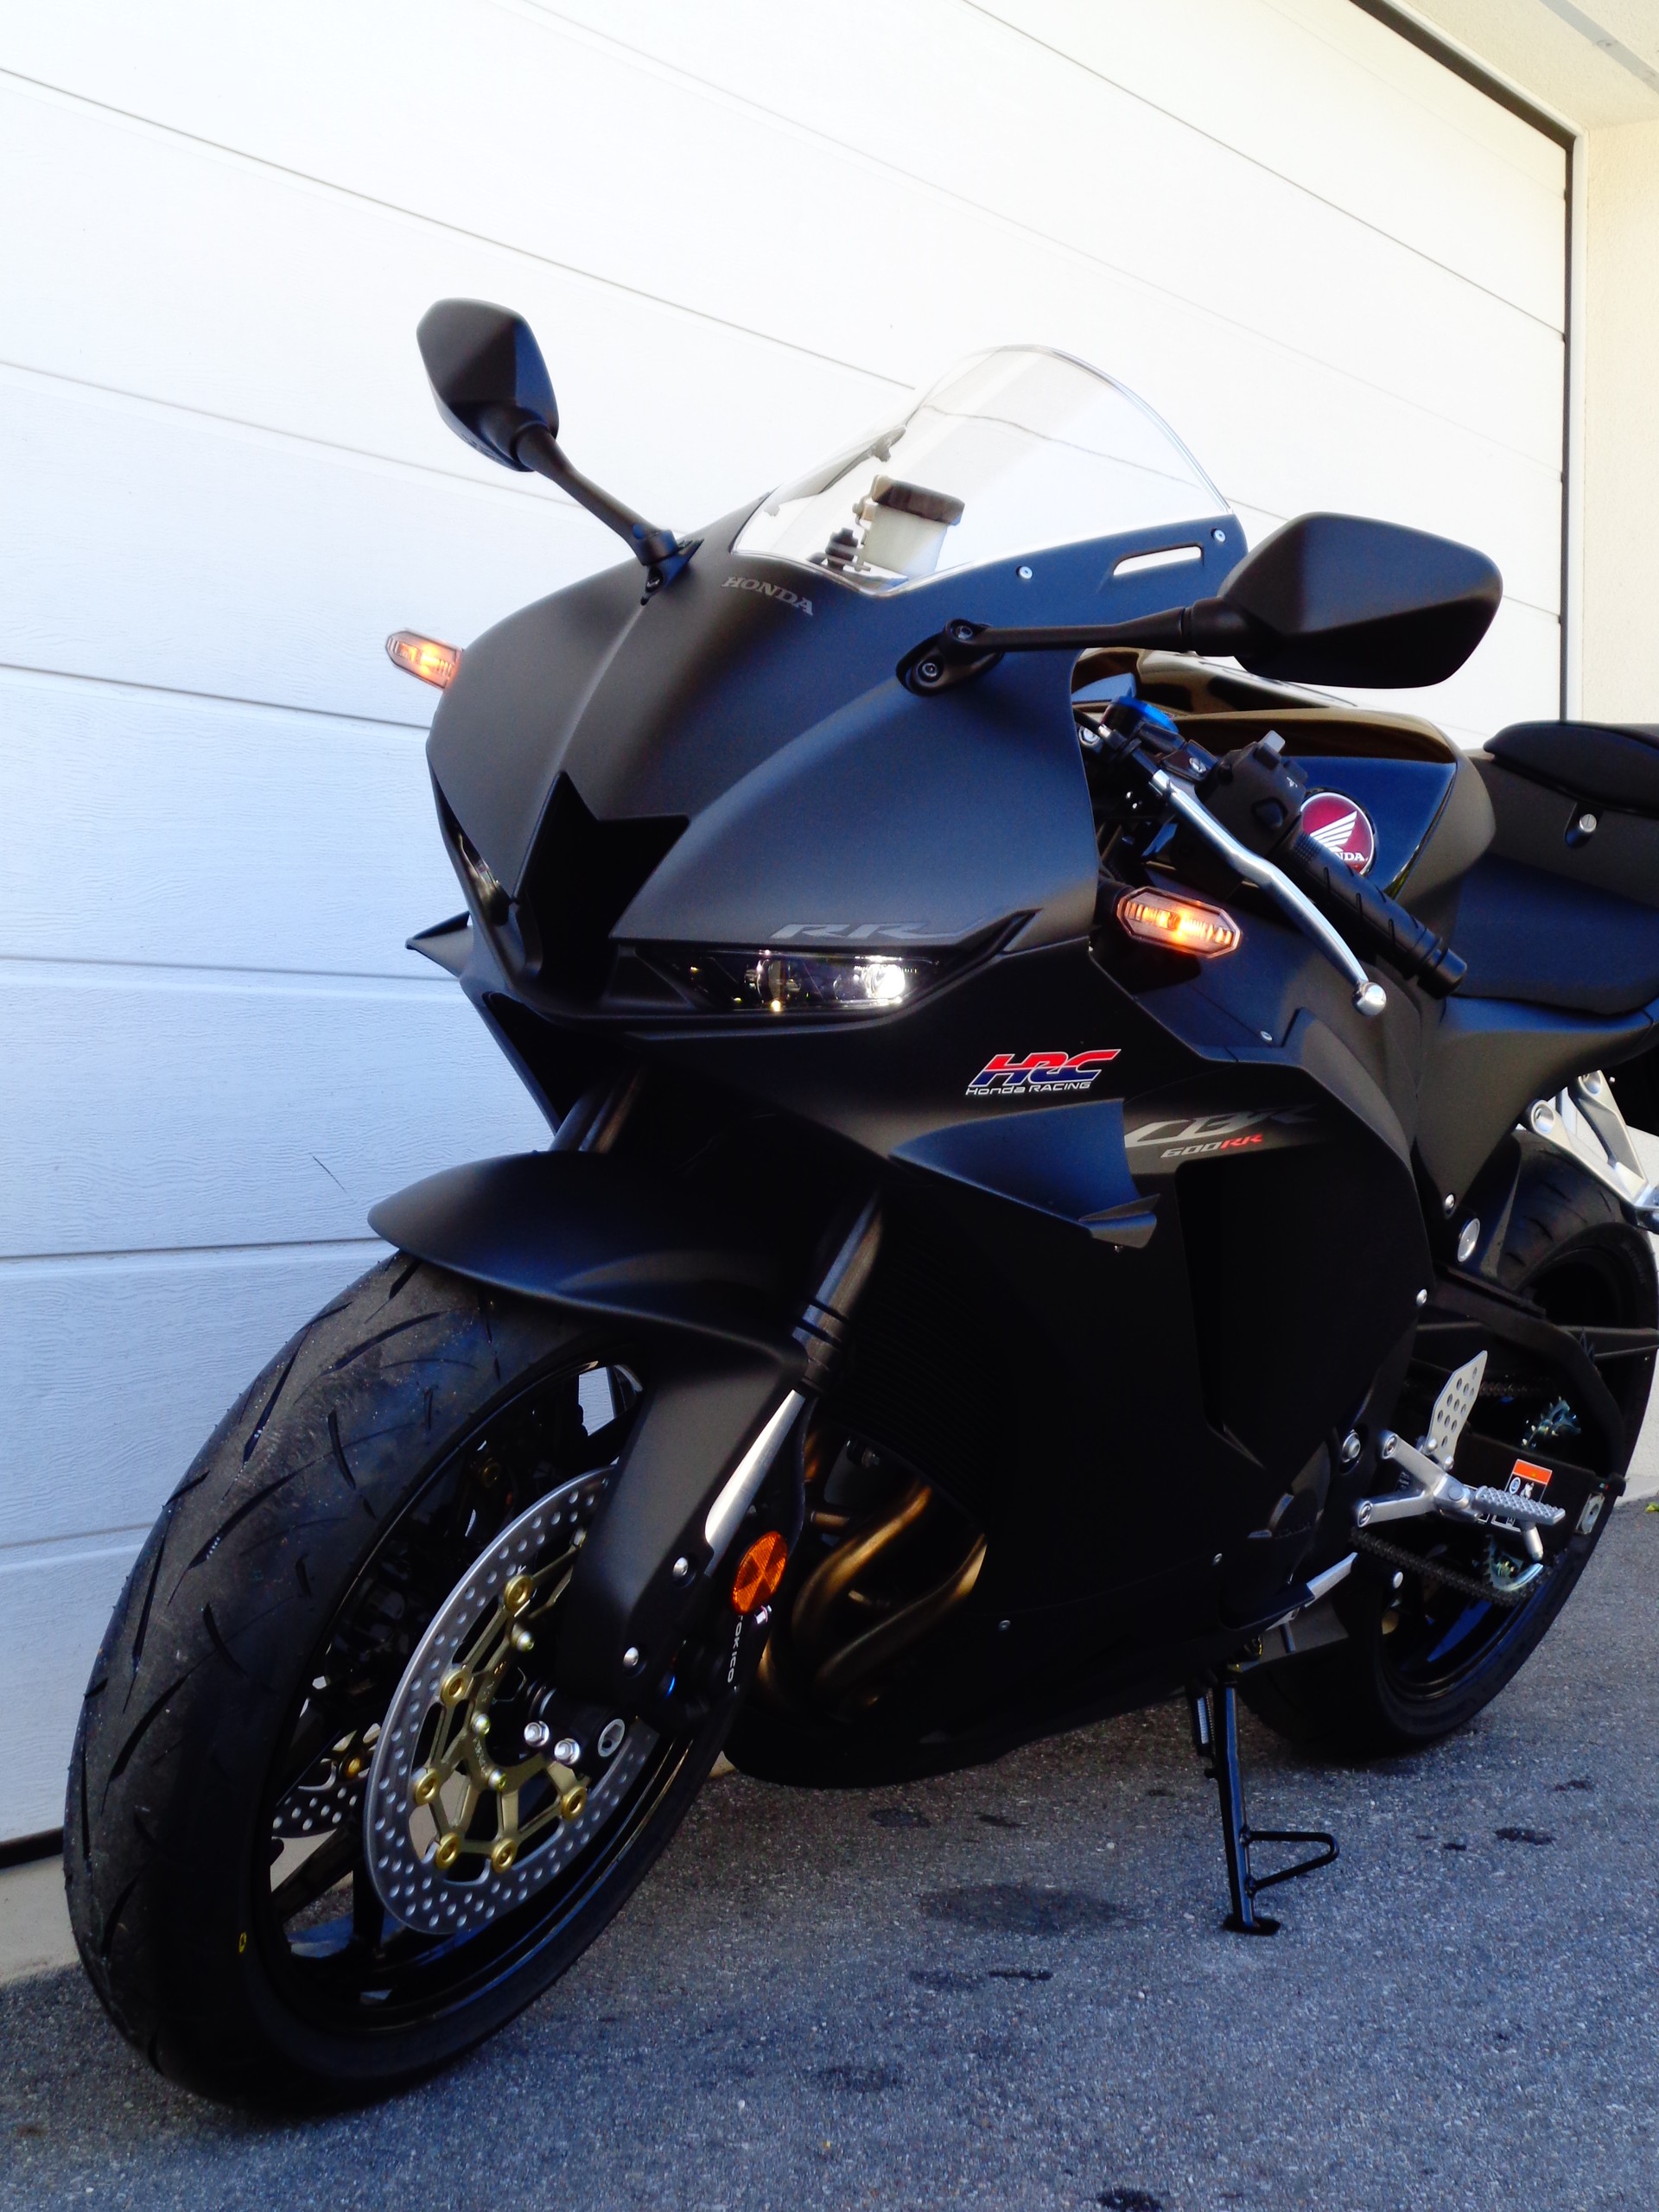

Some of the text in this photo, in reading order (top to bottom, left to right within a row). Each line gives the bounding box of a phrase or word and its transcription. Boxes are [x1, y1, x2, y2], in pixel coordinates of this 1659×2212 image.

[721, 576, 814, 616] HONDA
[1334, 852, 1365, 861] NDA
[769, 923, 957, 940] RR
[968, 1048, 1122, 1087] HRC
[965, 1082, 1092, 1096] Honda RACING
[1160, 1133, 1264, 1159] 600RR
